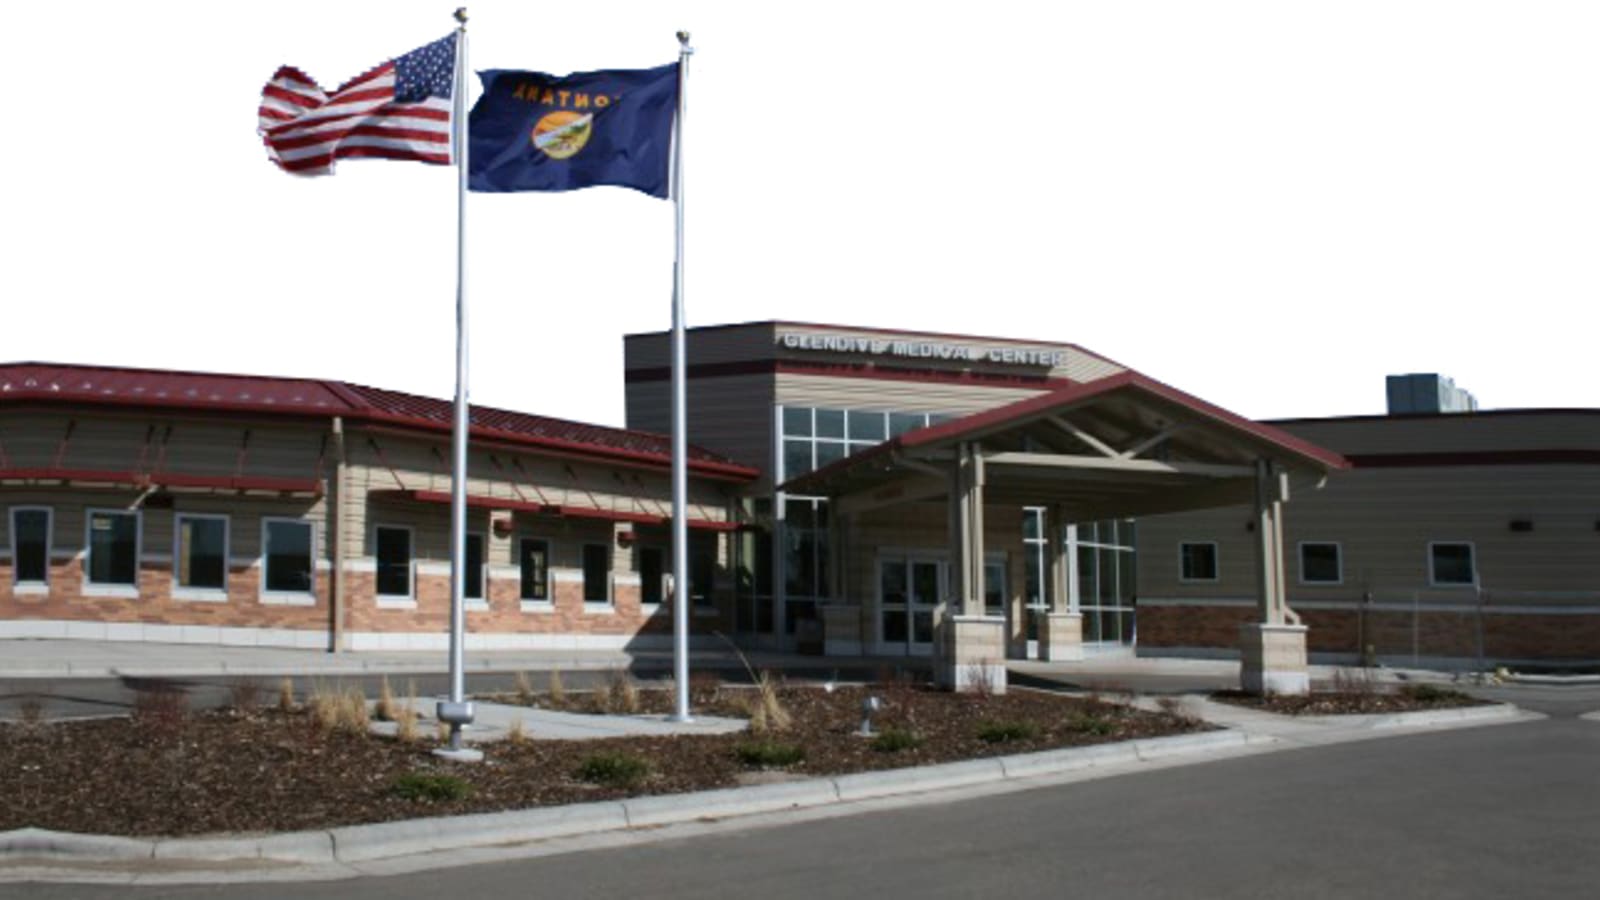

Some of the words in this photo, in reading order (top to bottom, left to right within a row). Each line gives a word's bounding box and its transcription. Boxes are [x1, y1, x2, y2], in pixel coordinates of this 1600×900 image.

[784, 332, 882, 352] GLENDIVE
[893, 340, 978, 359] MEDICAL
[990, 347, 1063, 366] CENTER
